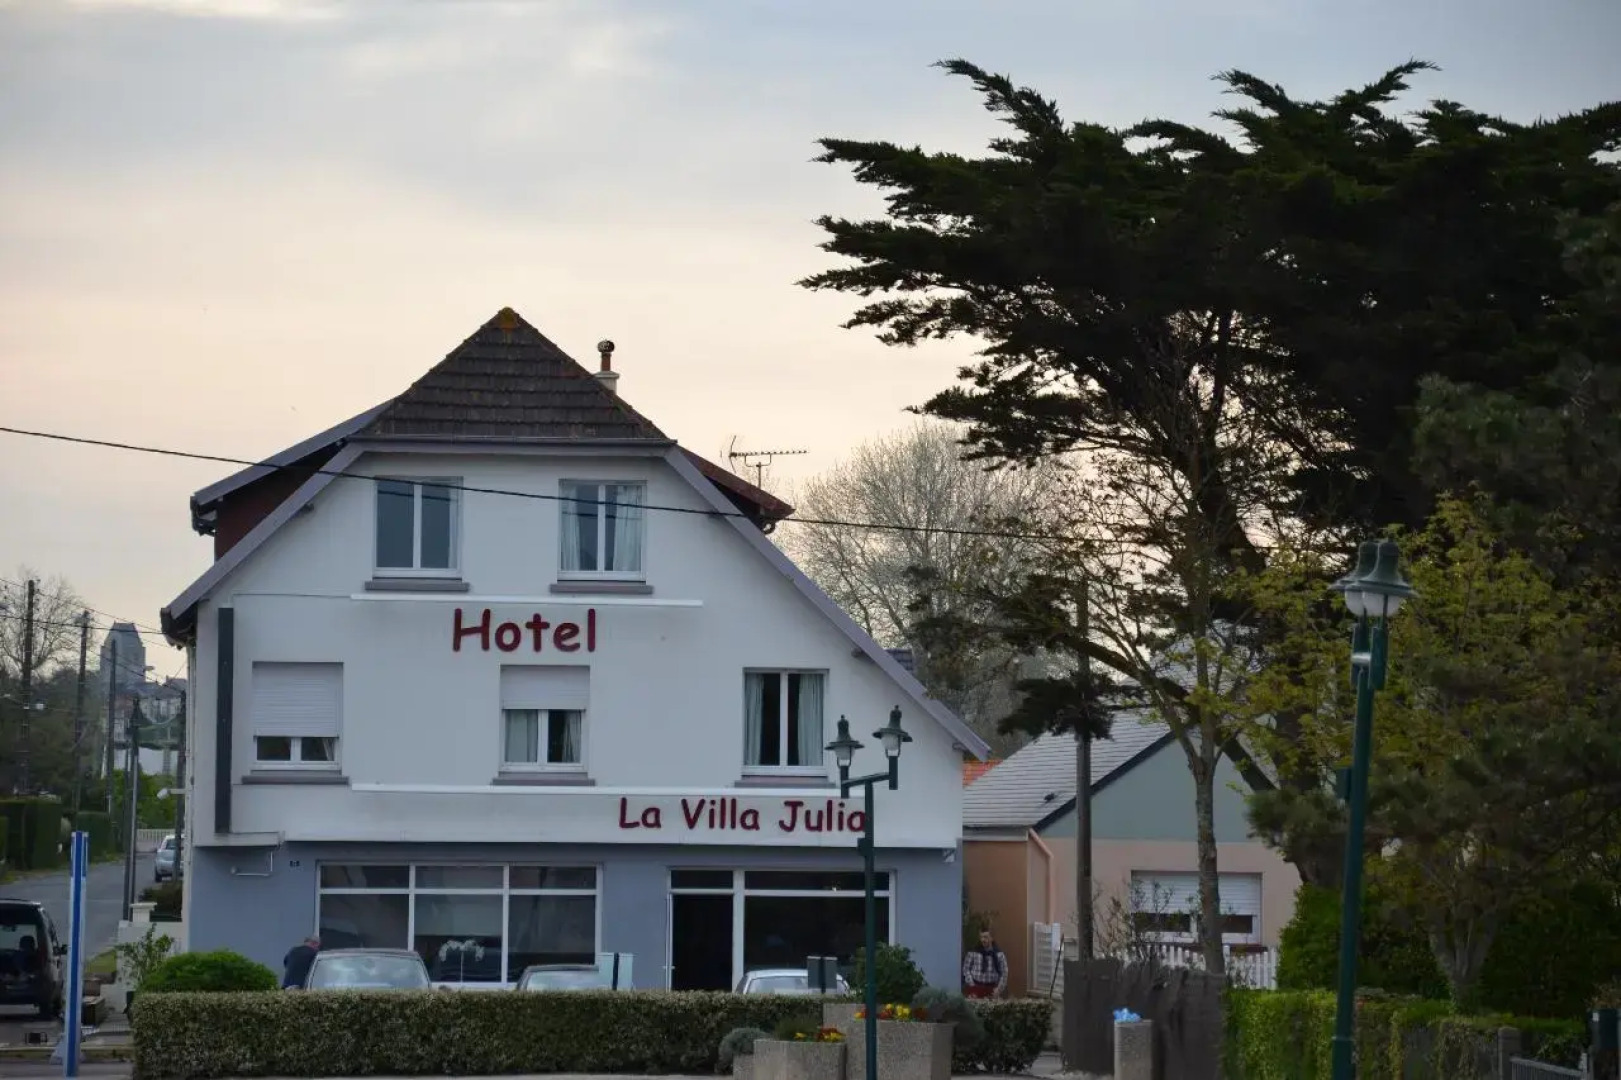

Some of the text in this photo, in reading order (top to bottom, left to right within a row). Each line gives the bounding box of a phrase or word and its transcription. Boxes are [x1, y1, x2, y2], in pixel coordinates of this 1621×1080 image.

[453, 608, 597, 653] Hotel
[619, 797, 866, 832] La Villa Julia
